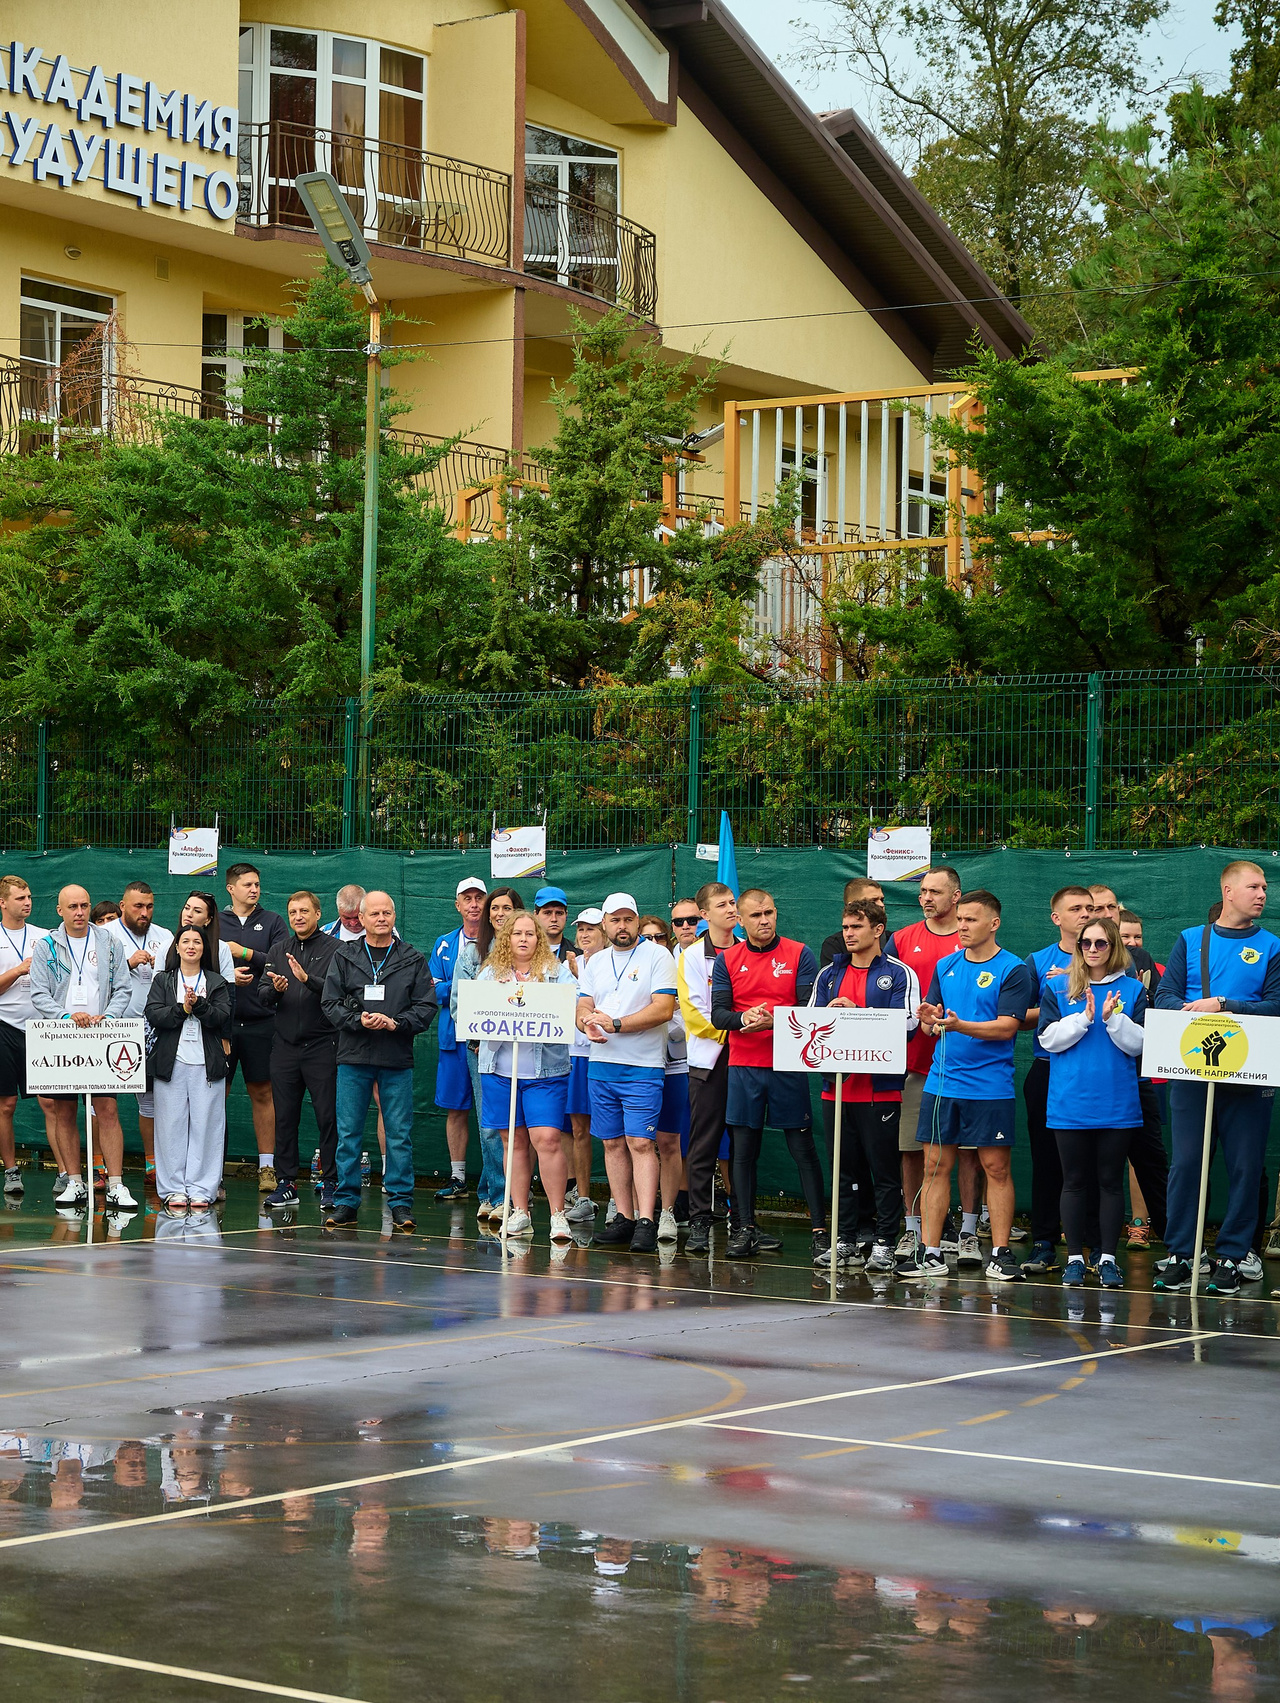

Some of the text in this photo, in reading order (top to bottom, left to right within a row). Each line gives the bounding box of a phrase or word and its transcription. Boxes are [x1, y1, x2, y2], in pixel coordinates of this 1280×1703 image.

[473, 1010, 560, 1019] «КРОПОТКИНЭЛЕКТРОСЕТЬ»
[31, 1021, 45, 1029] АО
[104, 1020, 139, 1030] Кубани»
[468, 1019, 564, 1037] «ФАКЕЛ»
[39, 1031, 131, 1041] «Крымскэлектросеть»
[813, 1045, 893, 1062] Феникс
[31, 1055, 103, 1067] «АЛЬФА»
[1157, 1066, 1268, 1081] ВЫСОКИЕ НАПРЯЖЕНИЯ
